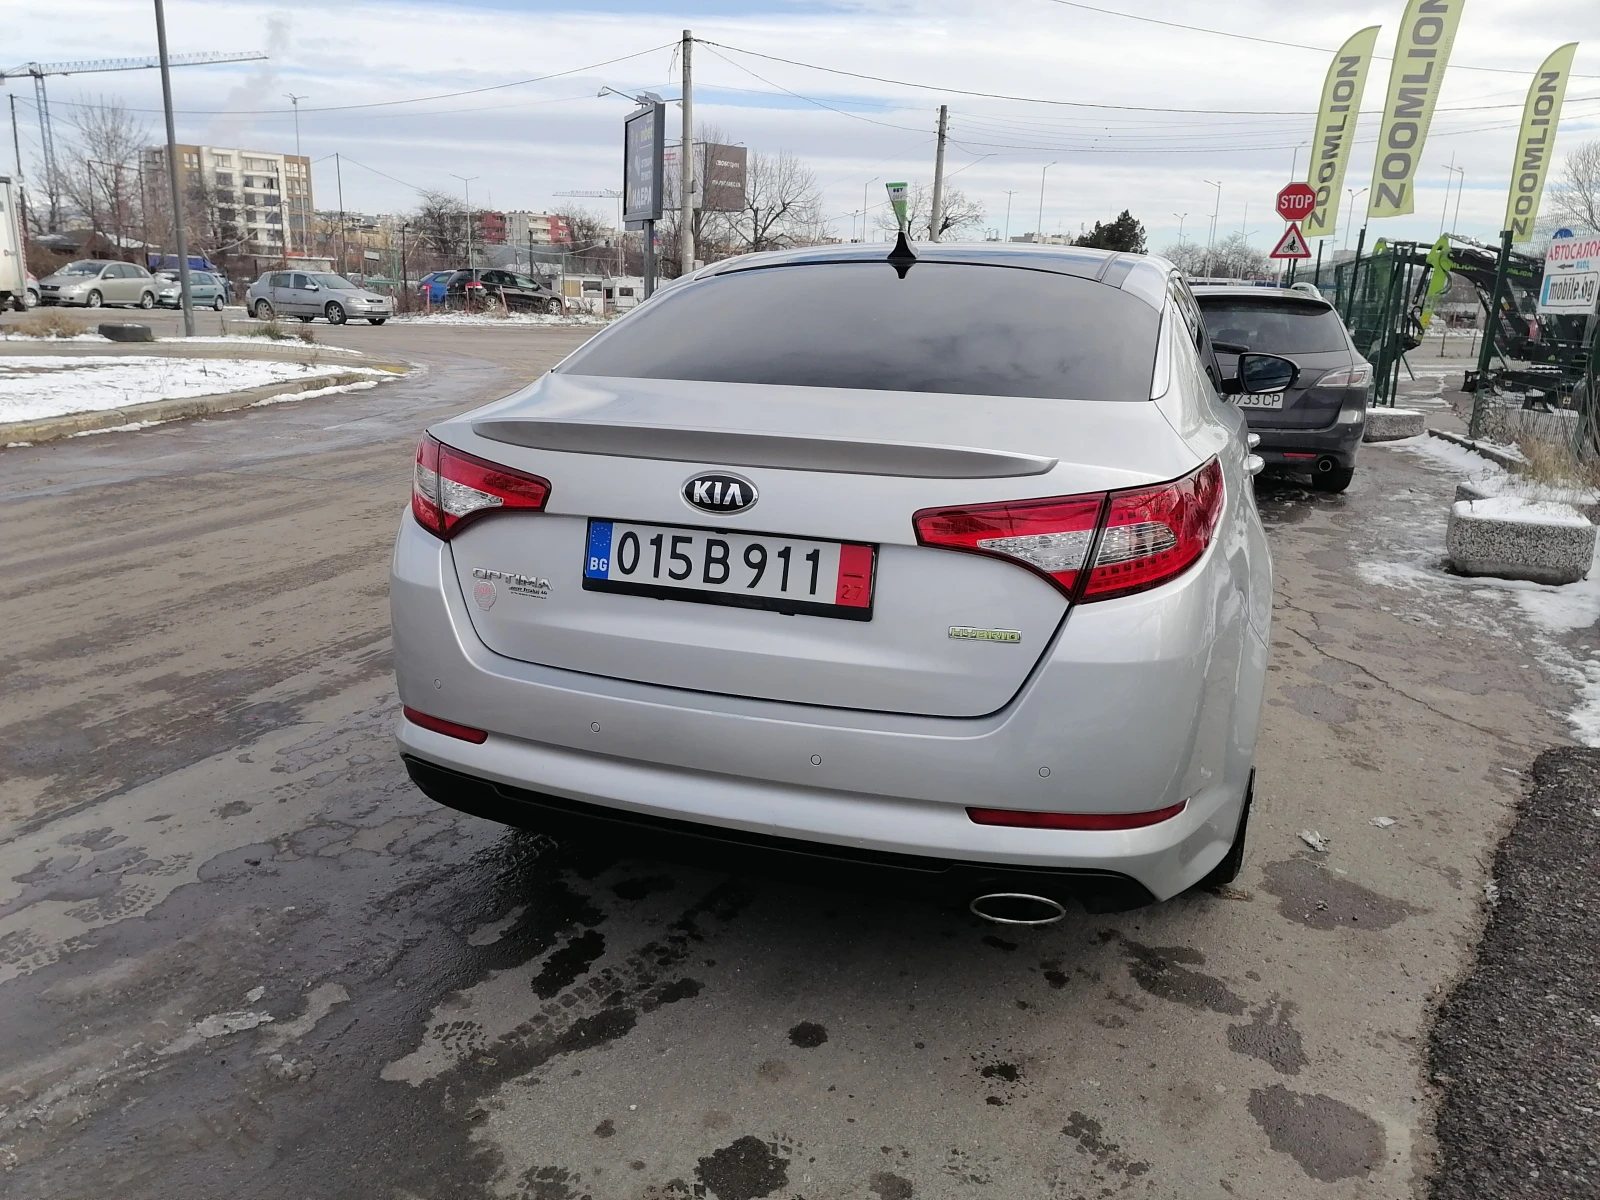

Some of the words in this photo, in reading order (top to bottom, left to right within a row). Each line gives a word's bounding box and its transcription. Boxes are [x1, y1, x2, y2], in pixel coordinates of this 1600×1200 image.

[1308, 56, 1360, 229] ZOOMLION
[1511, 72, 1560, 235] ZOOMLION
[1280, 194, 1313, 209] STOP
[1549, 276, 1595, 302] mobile.bg
[693, 480, 744, 506] KIA
[589, 556, 608, 572] BG
[472, 567, 553, 591] OPTIMA
[841, 583, 864, 601] 27
[951, 627, 1019, 641] HYBRID
